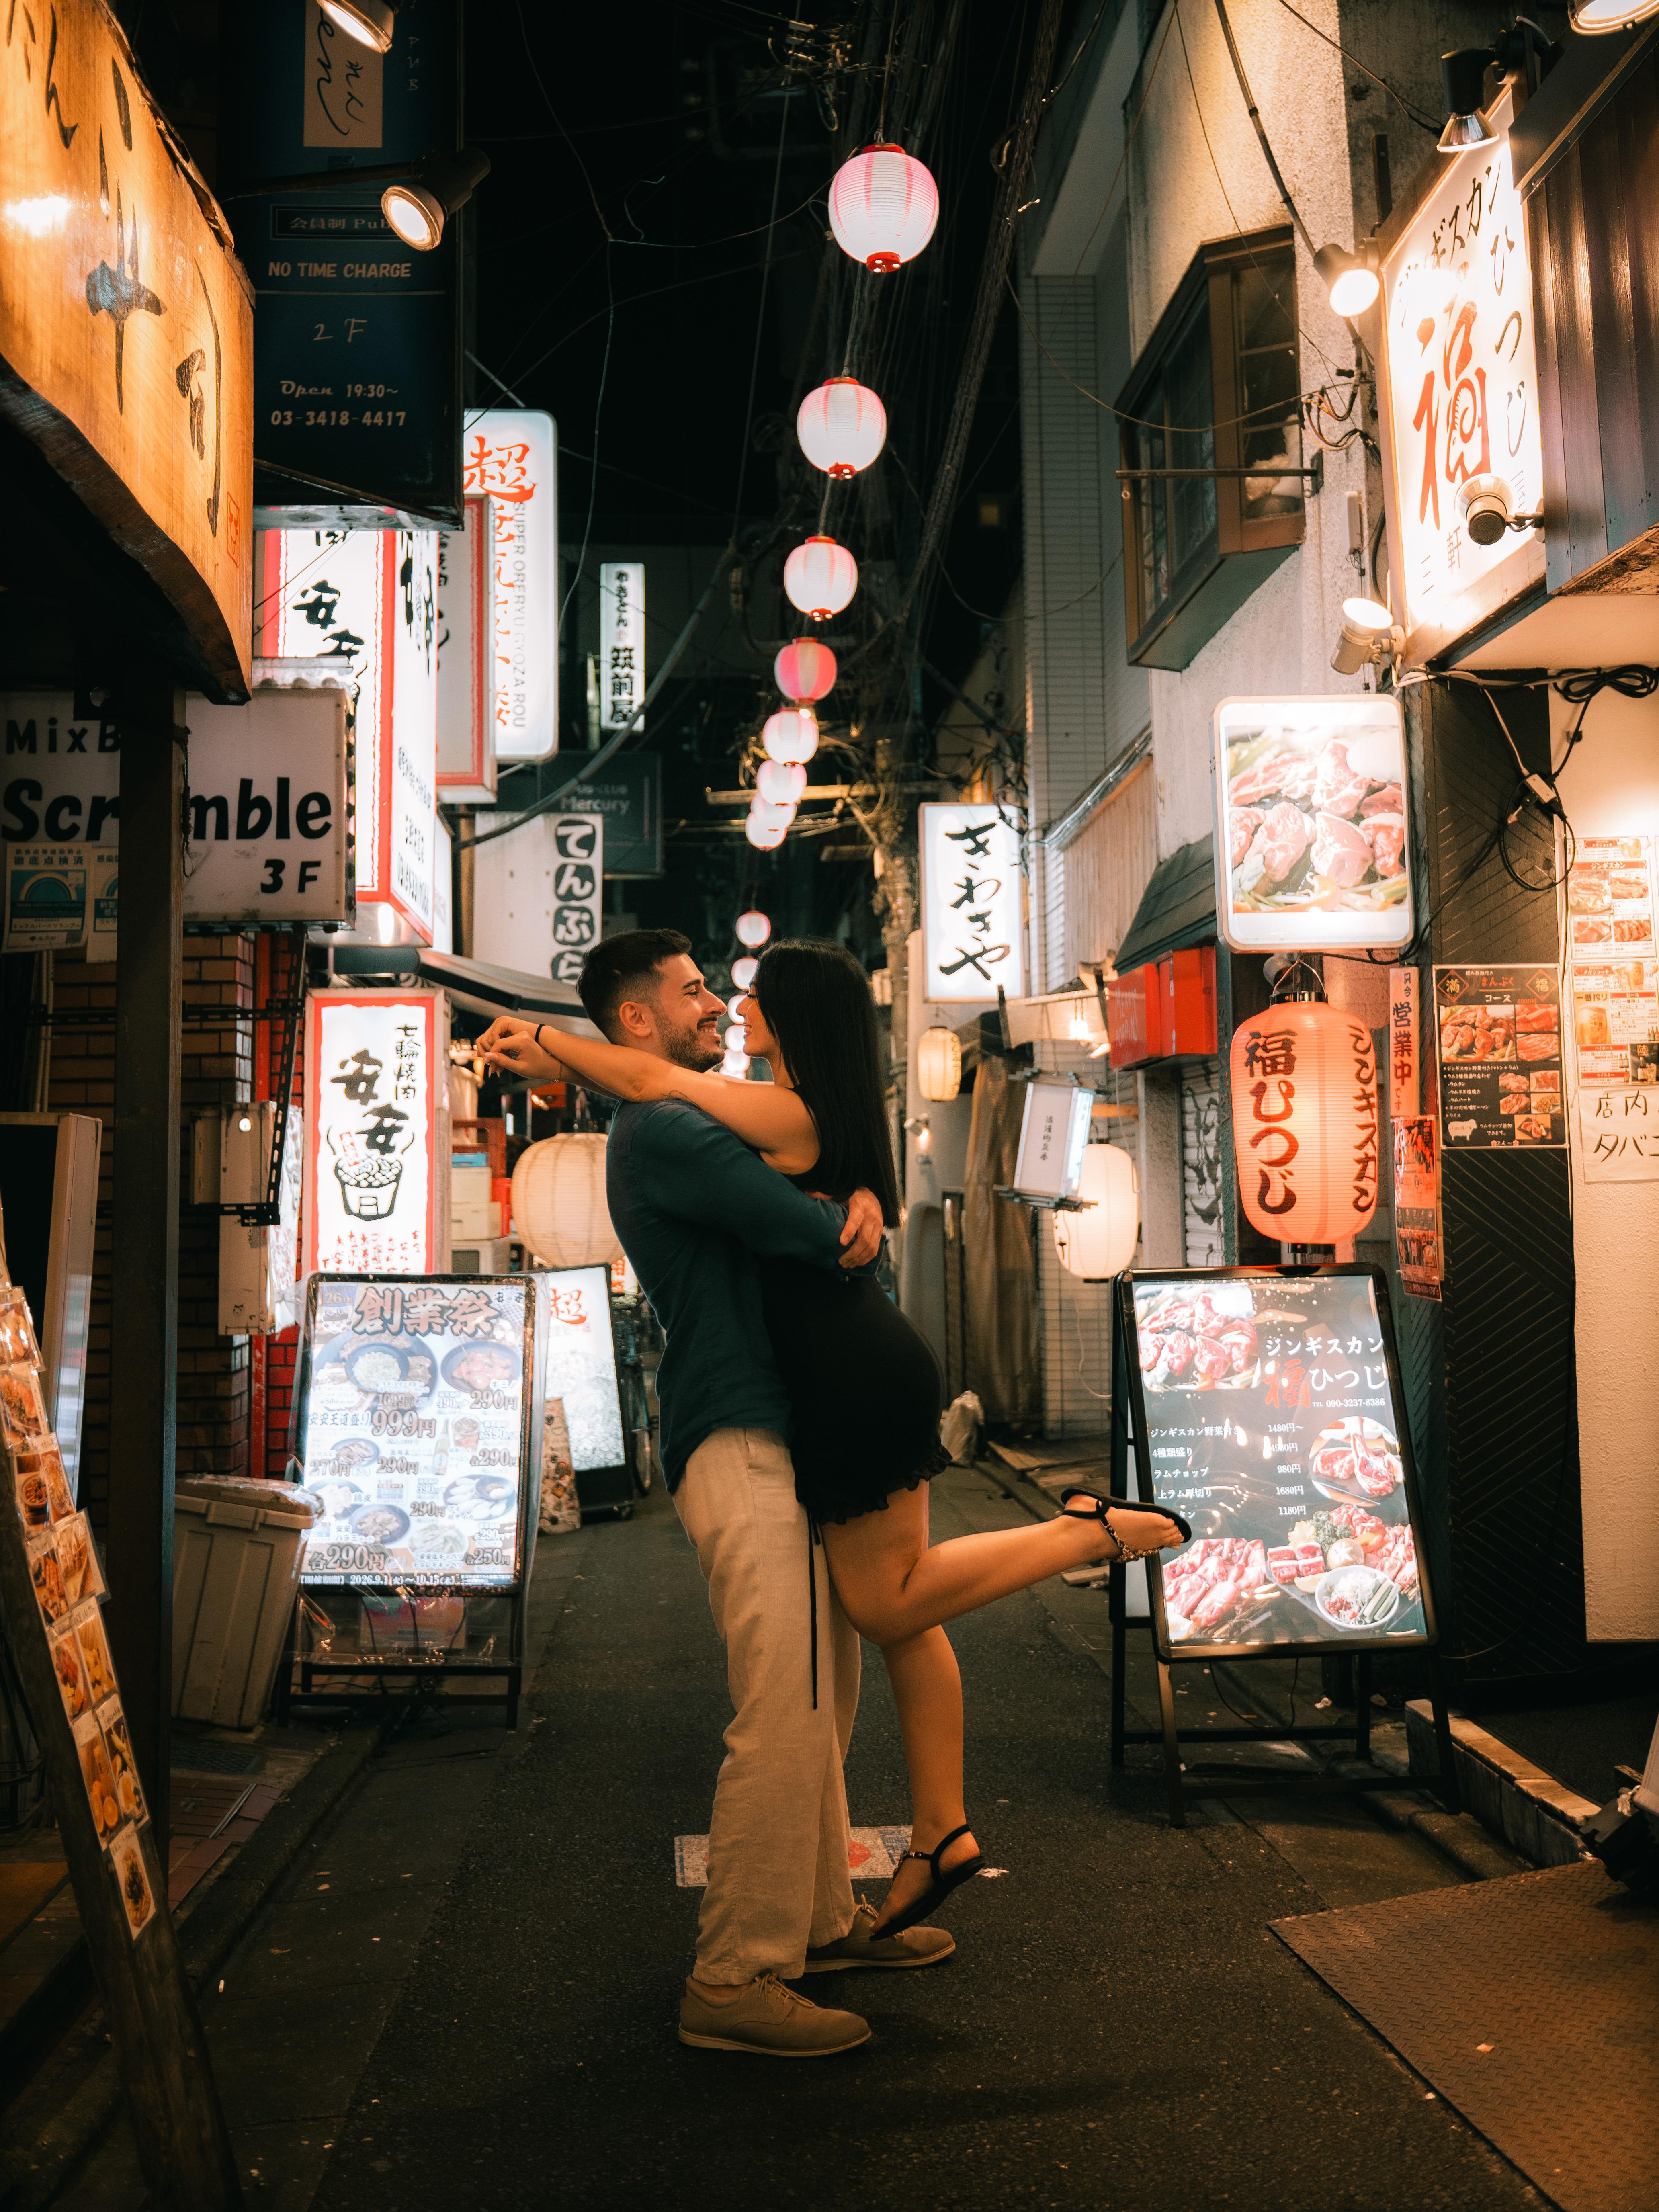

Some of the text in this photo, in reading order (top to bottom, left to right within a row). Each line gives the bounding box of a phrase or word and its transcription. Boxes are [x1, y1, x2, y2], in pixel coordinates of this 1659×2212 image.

[290, 217, 346, 229] 会員制
[268, 262, 412, 278] NO TIME CHARGE
[1489, 223, 1527, 458] ひつじ
[280, 380, 334, 397] Open
[271, 411, 406, 426] 03-3418-4417
[463, 435, 538, 503] 超
[513, 502, 527, 728] SUPER ORERYU GYOZA ROU
[1, 776, 332, 843] Scrmble
[14, 856, 84, 866] 徹底点検済
[1590, 862, 1626, 870] ジンギスカン
[1446, 978, 1460, 993] 満
[1485, 994, 1512, 1003] コース
[1576, 993, 1607, 1002] 一番搾り
[395, 1024, 421, 1100] 七輪焼肉
[1596, 1090, 1659, 1118] 店内
[1244, 1028, 1300, 1215] 福ひつじ
[352, 1286, 501, 1337] 創業祭
[1266, 1336, 1383, 1357] ジンギスカン
[1263, 1358, 1386, 1409] 福 ひつじ
[469, 1389, 518, 1410] 290円
[1325, 1398, 1386, 1407] 090-3237-8386
[371, 1409, 437, 1438] 999円
[1152, 1446, 1193, 1458] 4種類盛り
[309, 1459, 351, 1477] 270円
[376, 1456, 419, 1475] 290円
[1154, 1466, 1209, 1478] ラムチョップ
[1277, 1463, 1301, 1473] 980円
[1157, 1488, 1213, 1499] 上ラム厚切り
[1275, 1485, 1304, 1495] 1680円
[410, 1501, 446, 1517] 290円
[1179, 1510, 1196, 1519] タン
[1278, 1505, 1307, 1515] 1180円
[309, 1544, 386, 1571] 各290円
[465, 1548, 511, 1566] 各250円
